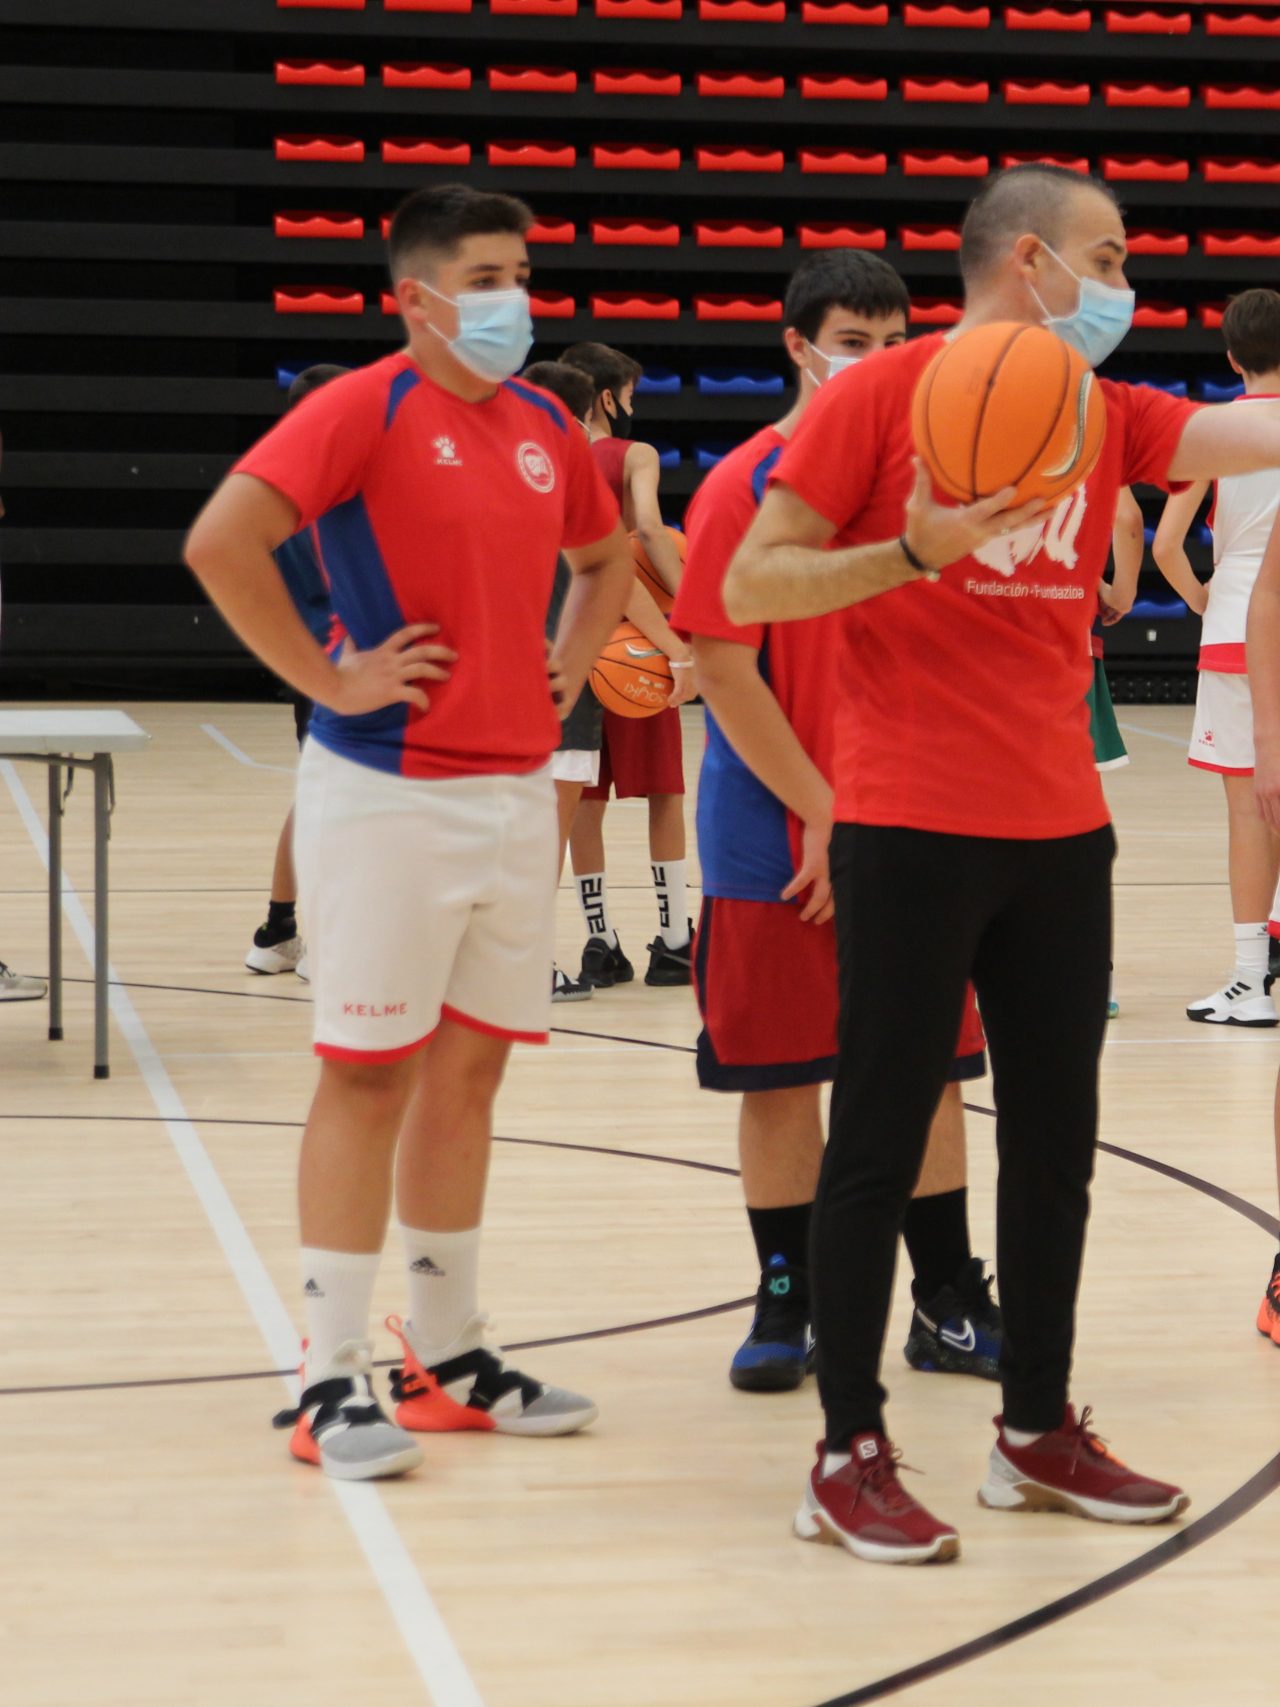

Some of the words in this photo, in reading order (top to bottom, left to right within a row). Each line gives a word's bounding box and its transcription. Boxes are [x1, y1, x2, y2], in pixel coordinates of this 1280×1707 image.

[966, 579, 1029, 598] Fundación
[580, 876, 607, 935] ELITE
[343, 1001, 408, 1017] KELME
